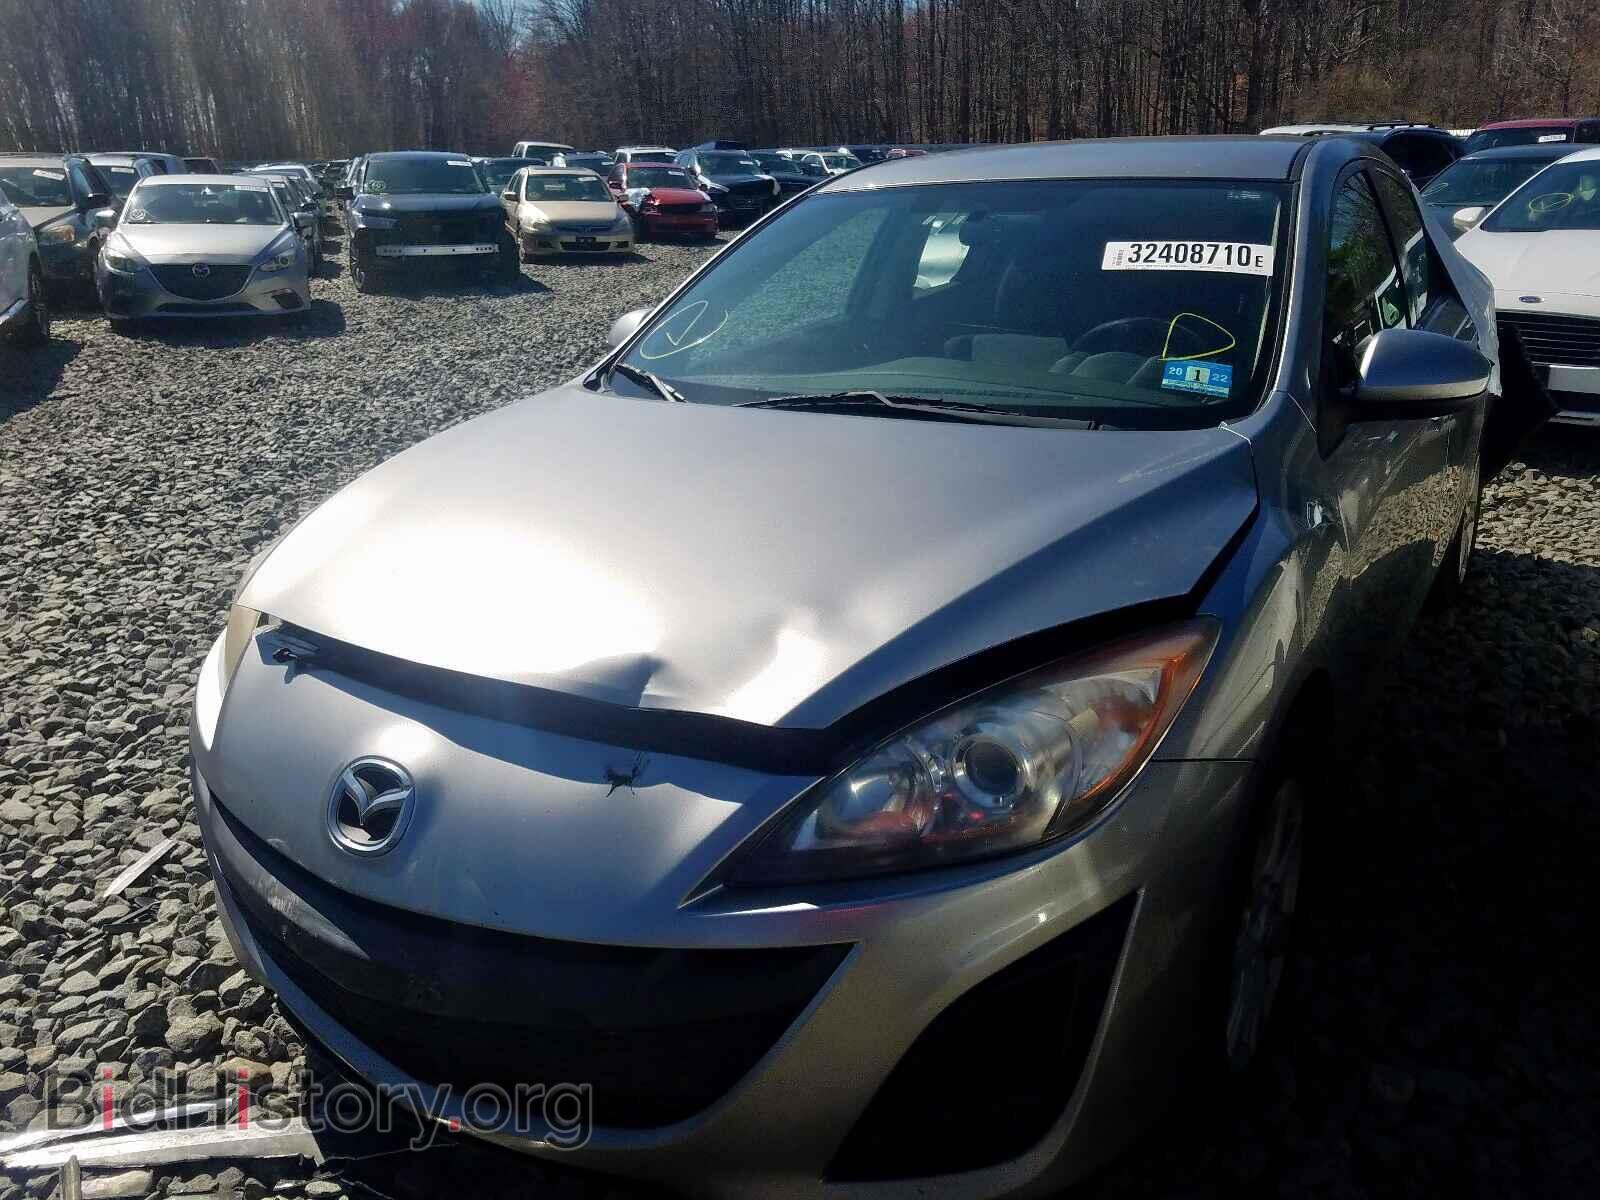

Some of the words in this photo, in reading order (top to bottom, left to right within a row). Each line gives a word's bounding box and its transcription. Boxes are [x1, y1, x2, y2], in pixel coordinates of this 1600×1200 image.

[1127, 243, 1252, 267] 32408710
[1255, 255, 1264, 268] E
[1211, 373, 1228, 383] 22
